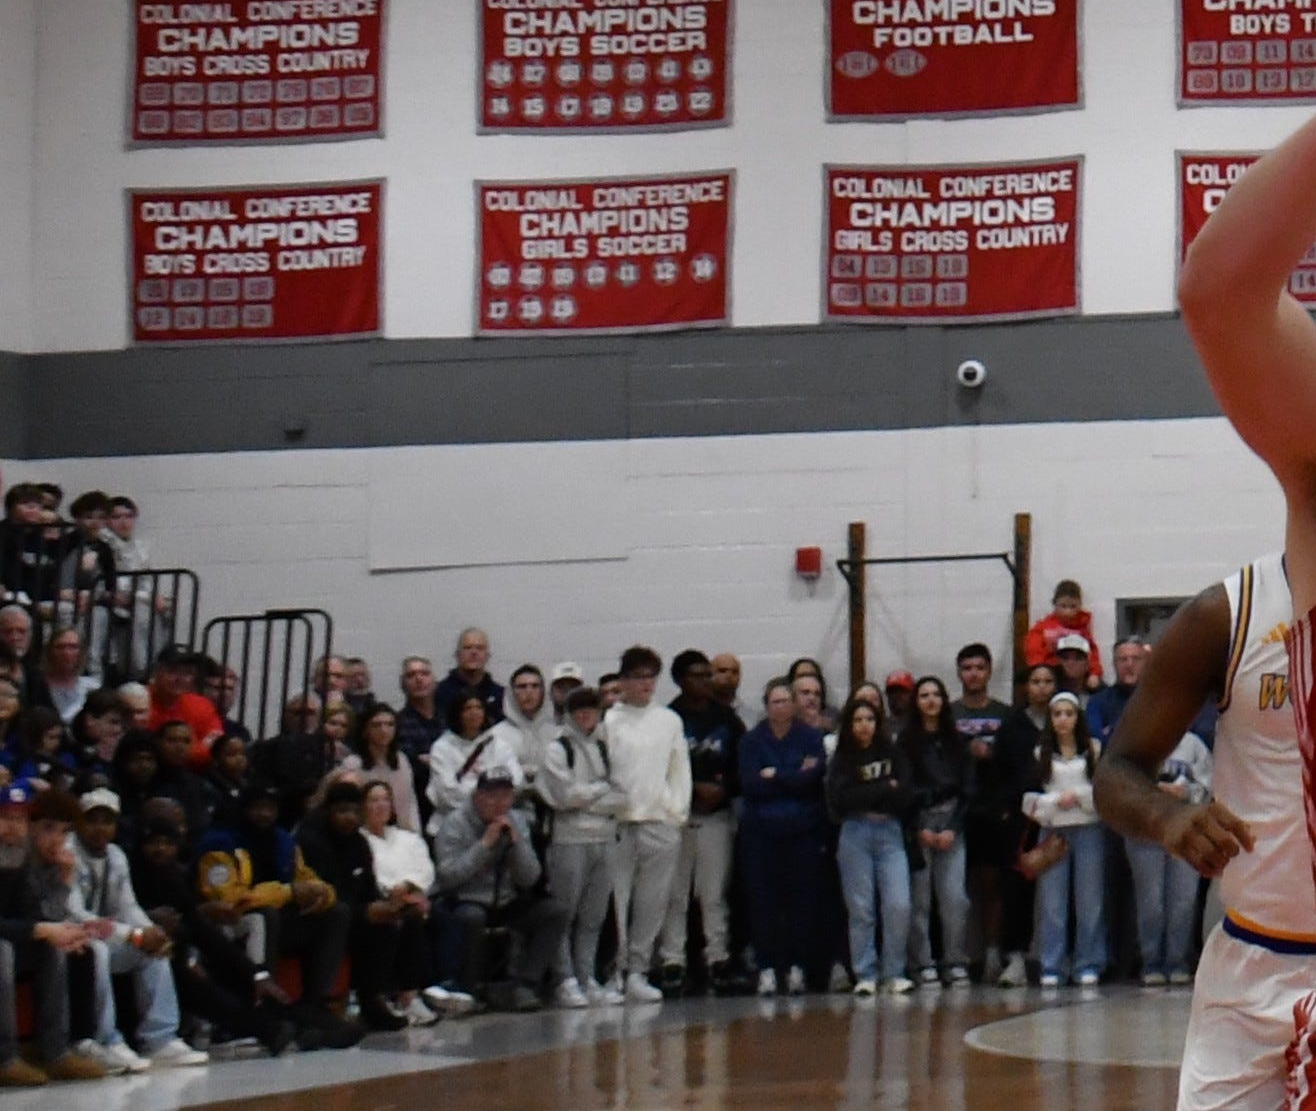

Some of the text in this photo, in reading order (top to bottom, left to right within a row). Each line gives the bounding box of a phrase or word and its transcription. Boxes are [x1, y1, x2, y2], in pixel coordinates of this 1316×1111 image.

[140, 3, 238, 23] COLONIAL
[504, 5, 707, 35] CHAMPIONS
[1230, 13, 1291, 35] BOYS
[158, 22, 360, 52] CHAMPIONS
[504, 31, 706, 57] BOYS SOCCER
[873, 21, 1034, 48] FOOTBALL
[144, 49, 370, 76] BOYS CROSS COUNTRY
[486, 181, 725, 211] COLONIAL CONFERENCE
[833, 170, 1073, 198] COLONIAL CONFERENCE
[141, 193, 372, 222] COLONIAL CONFERENCE
[520, 206, 689, 237] CHAMPIONS
[850, 196, 1056, 227] CHAMPIONS
[154, 218, 358, 250] CHAMPIONS
[522, 233, 687, 259] GIRLS SOCCER
[834, 223, 1070, 252] GIRLS CROSS COUNTRY
[144, 246, 366, 274] BOYS CROSS COUNTRY
